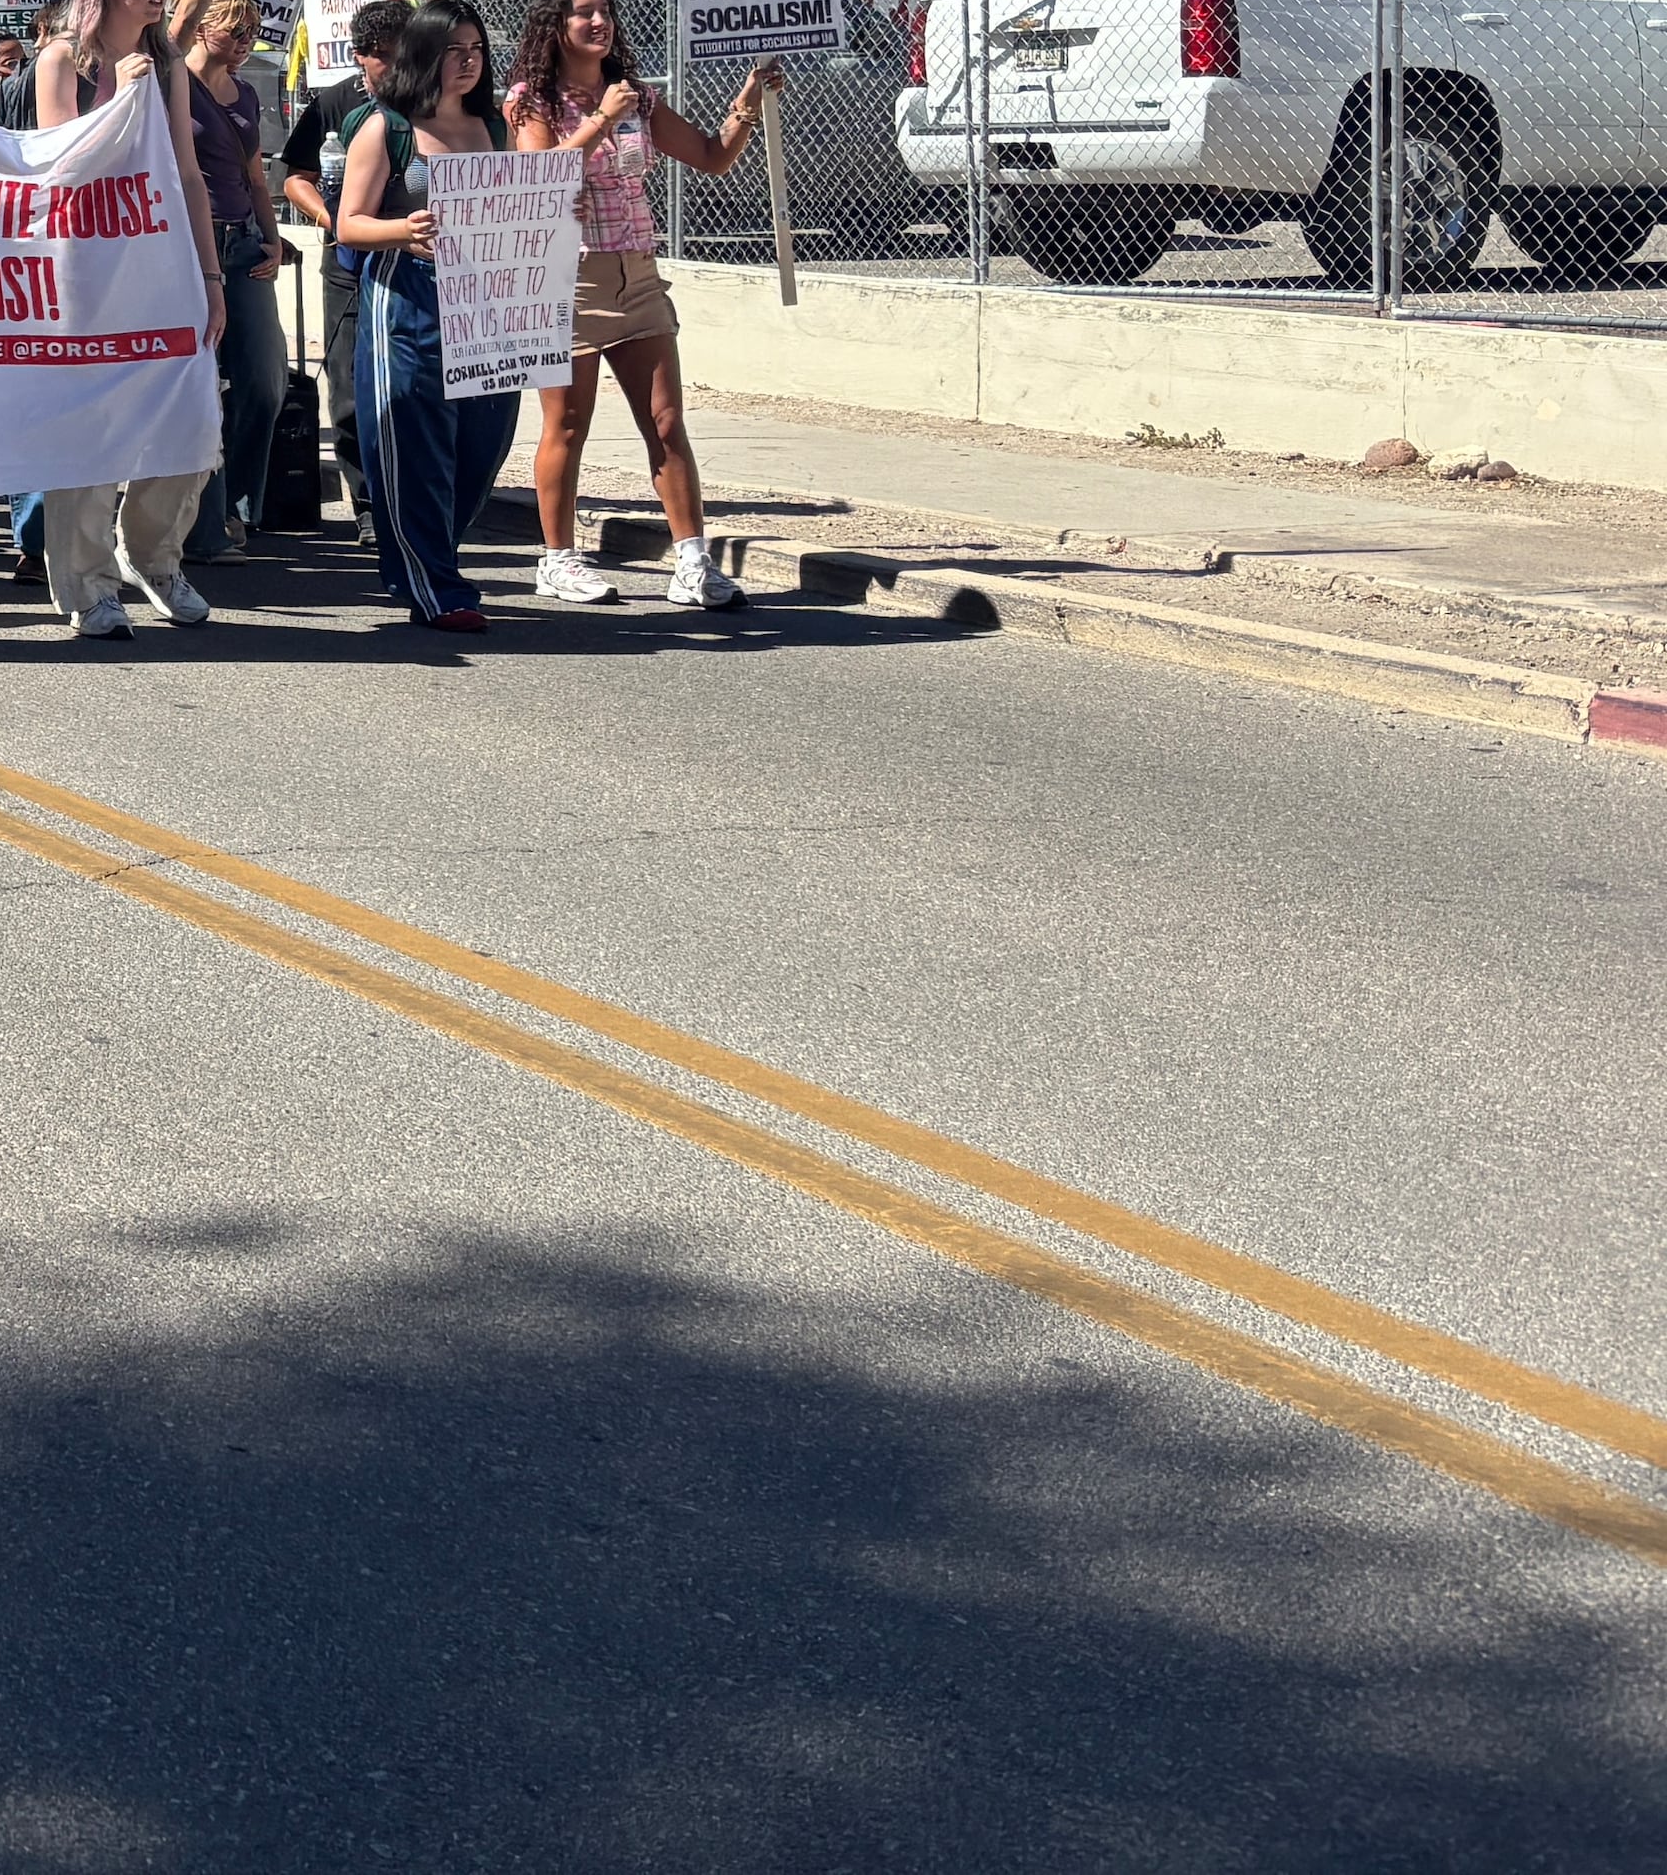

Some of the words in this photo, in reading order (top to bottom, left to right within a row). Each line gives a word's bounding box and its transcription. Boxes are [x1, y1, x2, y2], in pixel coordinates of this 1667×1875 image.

[690, 0, 832, 34] SOCIALISM!
[693, 40, 741, 55] STUDENTS
[743, 38, 760, 51] FOR
[762, 34, 810, 50] SOCIALISM
[821, 32, 835, 44] UA
[430, 157, 465, 193] KICK
[469, 154, 514, 190] DOWN
[518, 151, 539, 186] THE
[542, 149, 582, 183] DOORS
[46, 172, 169, 240] HOUSE:
[430, 198, 448, 228] OF
[451, 197, 480, 226] THE
[481, 189, 566, 225] MIGHTIEST
[433, 235, 462, 267] MEN
[471, 231, 504, 262] TILL
[513, 229, 555, 260] THEY
[439, 273, 477, 306] NEVER
[526, 265, 546, 296] TO
[443, 309, 476, 345] DENY
[480, 306, 498, 338] US
[12, 335, 169, 360] @FORCE_UA
[519, 354, 538, 368] YOU
[540, 350, 570, 366] HEAR
[481, 377, 495, 391] US
